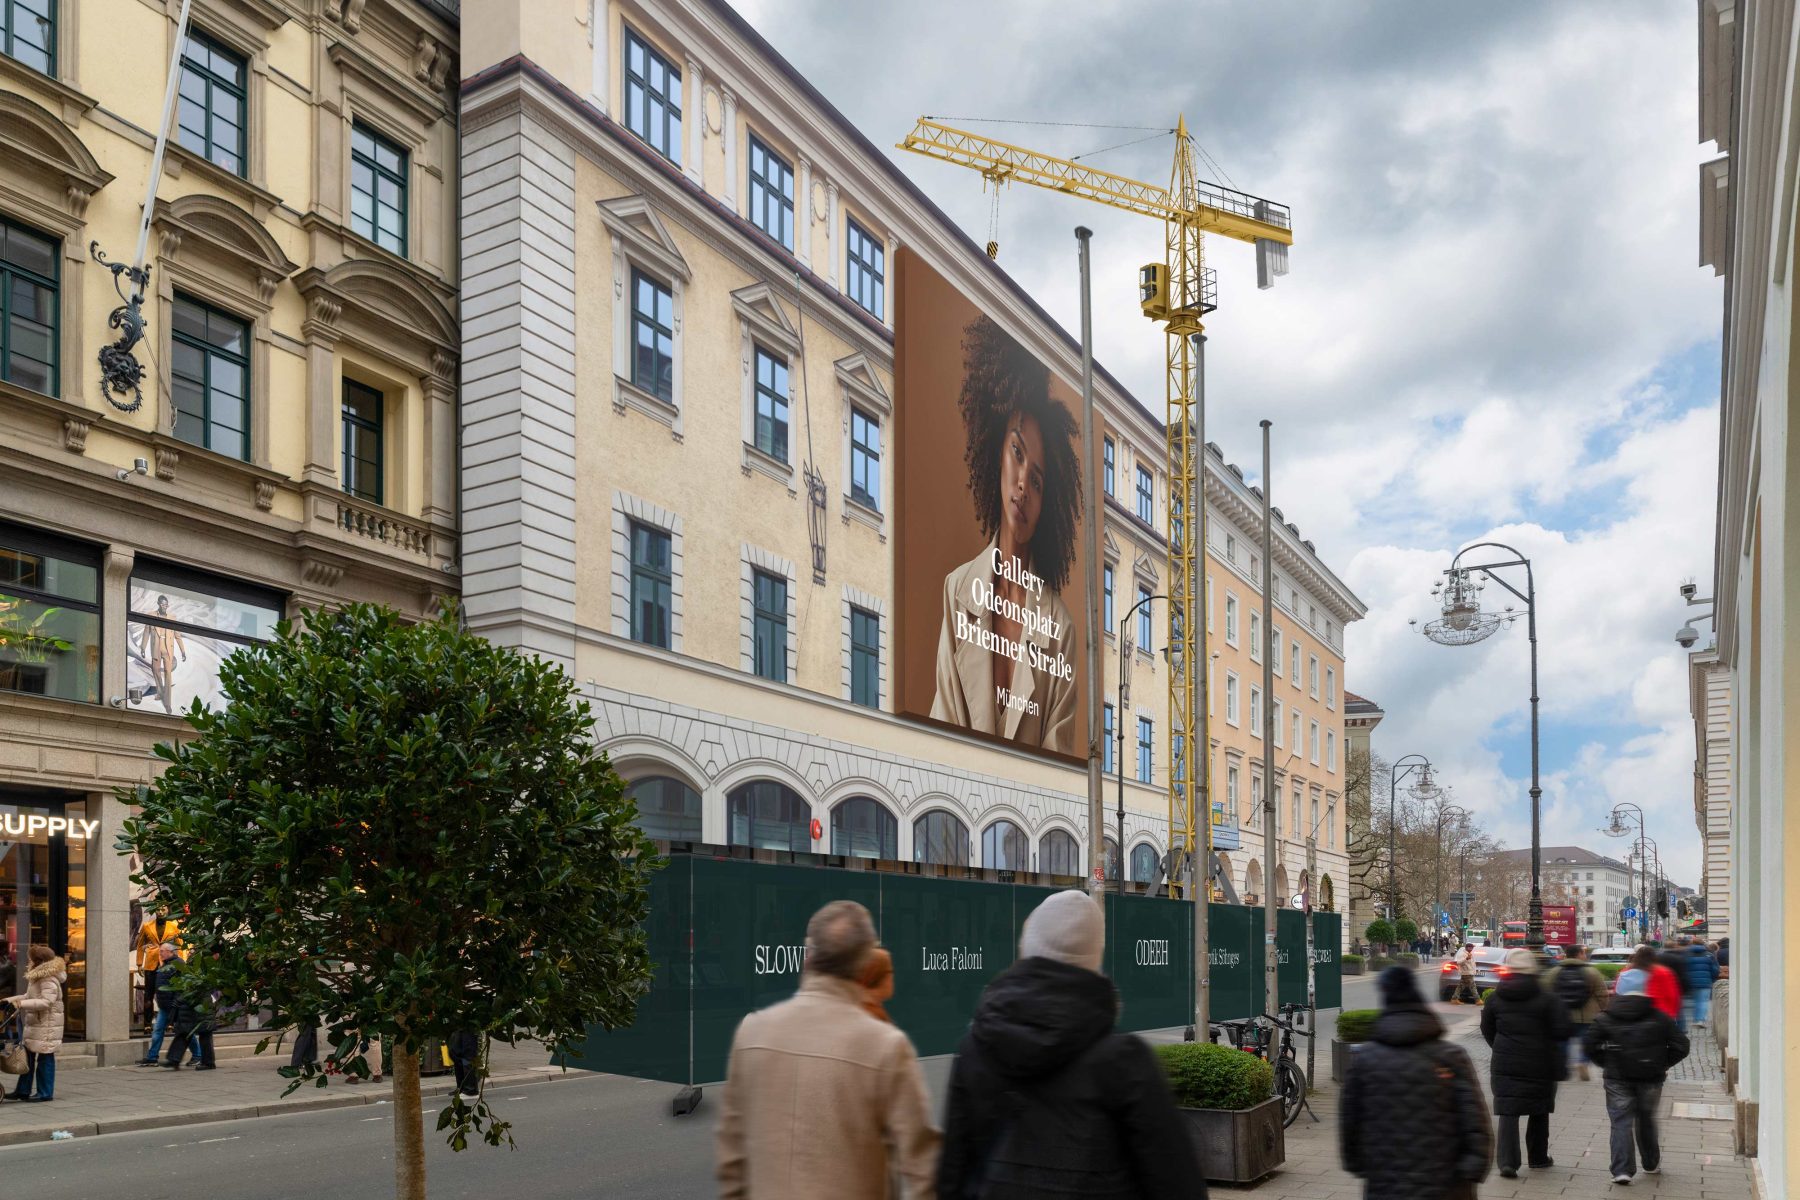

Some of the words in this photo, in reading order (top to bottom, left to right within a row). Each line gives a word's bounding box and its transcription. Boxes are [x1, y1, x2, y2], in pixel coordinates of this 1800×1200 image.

[991, 547, 1045, 601] Gallery
[971, 577, 1061, 641] Odeonsplatz
[955, 610, 1025, 663] Brienner
[1028, 642, 1072, 682] Straße
[996, 685, 1039, 717] München
[0, 813, 100, 839] UPPLY
[922, 946, 949, 971] Luca
[951, 946, 983, 971] Faloni
[1135, 939, 1169, 966] ODEEH
